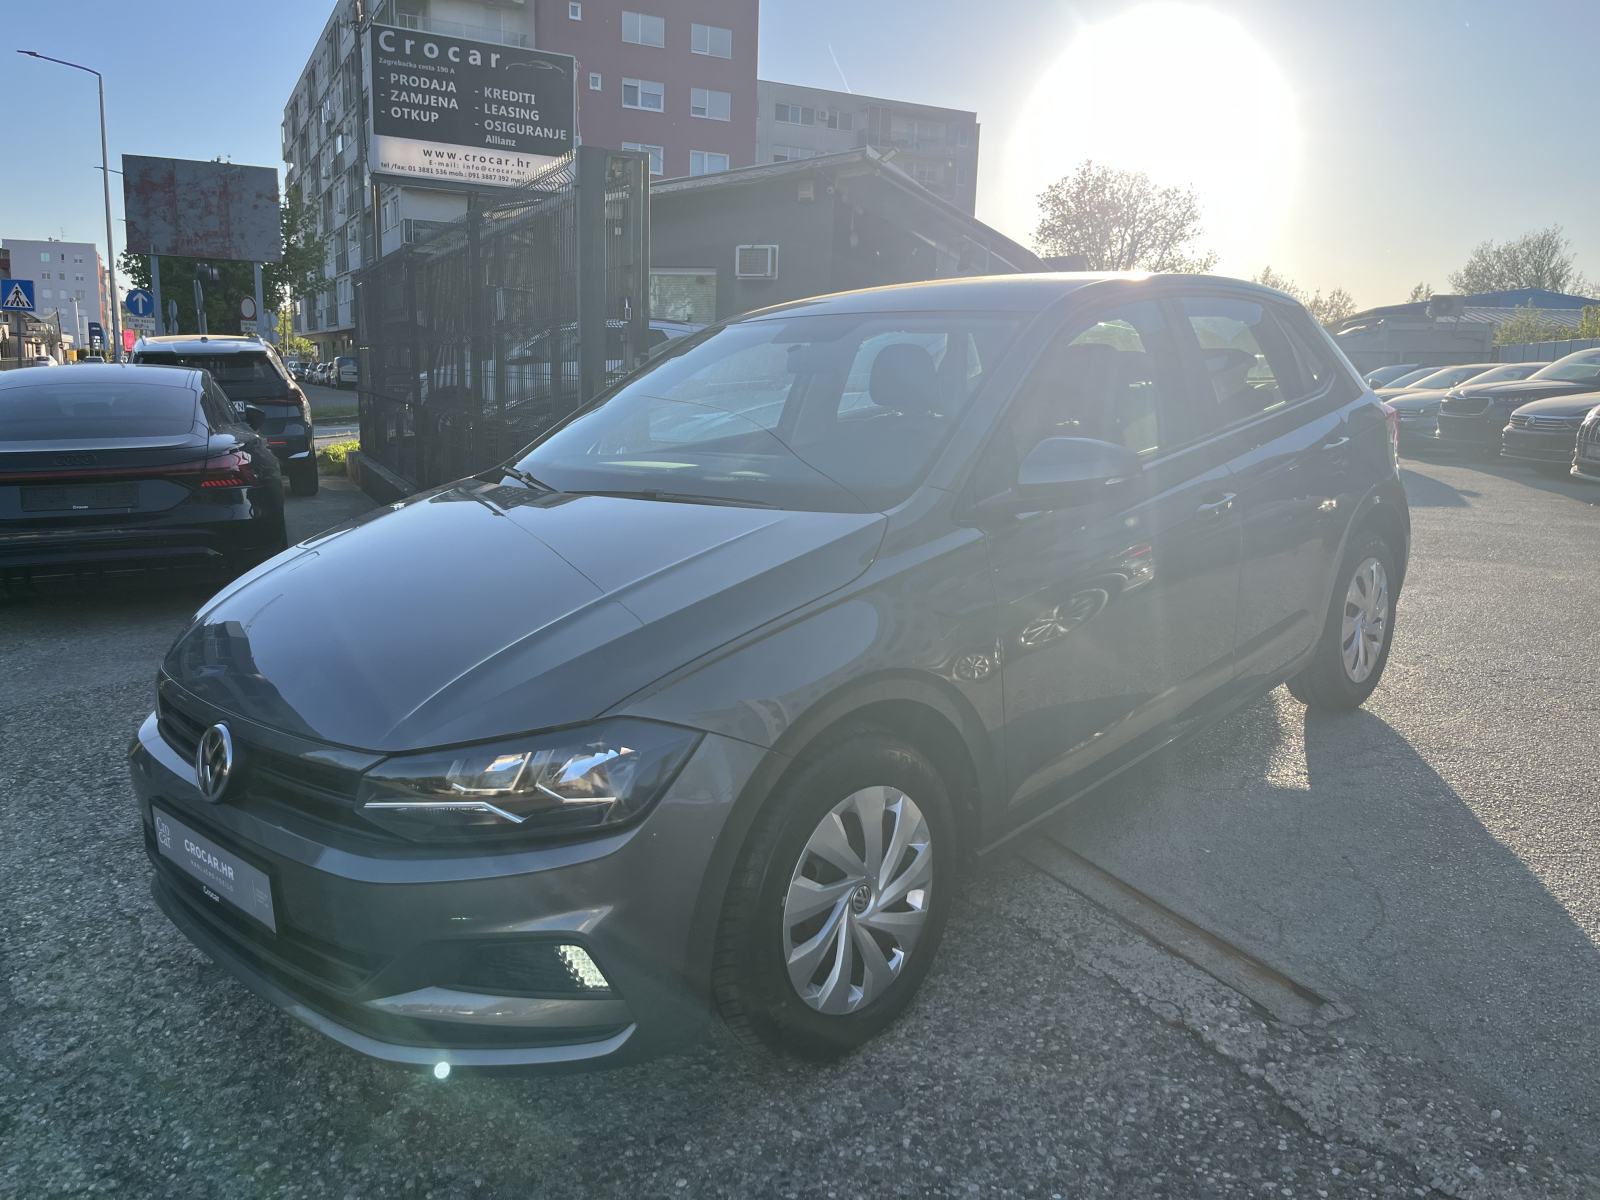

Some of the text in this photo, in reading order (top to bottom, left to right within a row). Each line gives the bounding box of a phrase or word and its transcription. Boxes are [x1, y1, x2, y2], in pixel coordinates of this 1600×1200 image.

[378, 30, 501, 68] Crocar
[390, 72, 457, 93] PRODAJA
[390, 90, 459, 110] ZAMJENA
[484, 87, 536, 105] KREDITI
[391, 106, 440, 123] OTKUP
[484, 103, 540, 121] LEASING
[484, 119, 567, 141] OSIGURANJE
[485, 134, 517, 147] Allianz
[422, 148, 531, 169] www.crocar.hr
[184, 839, 234, 881] CROCAR.HR
